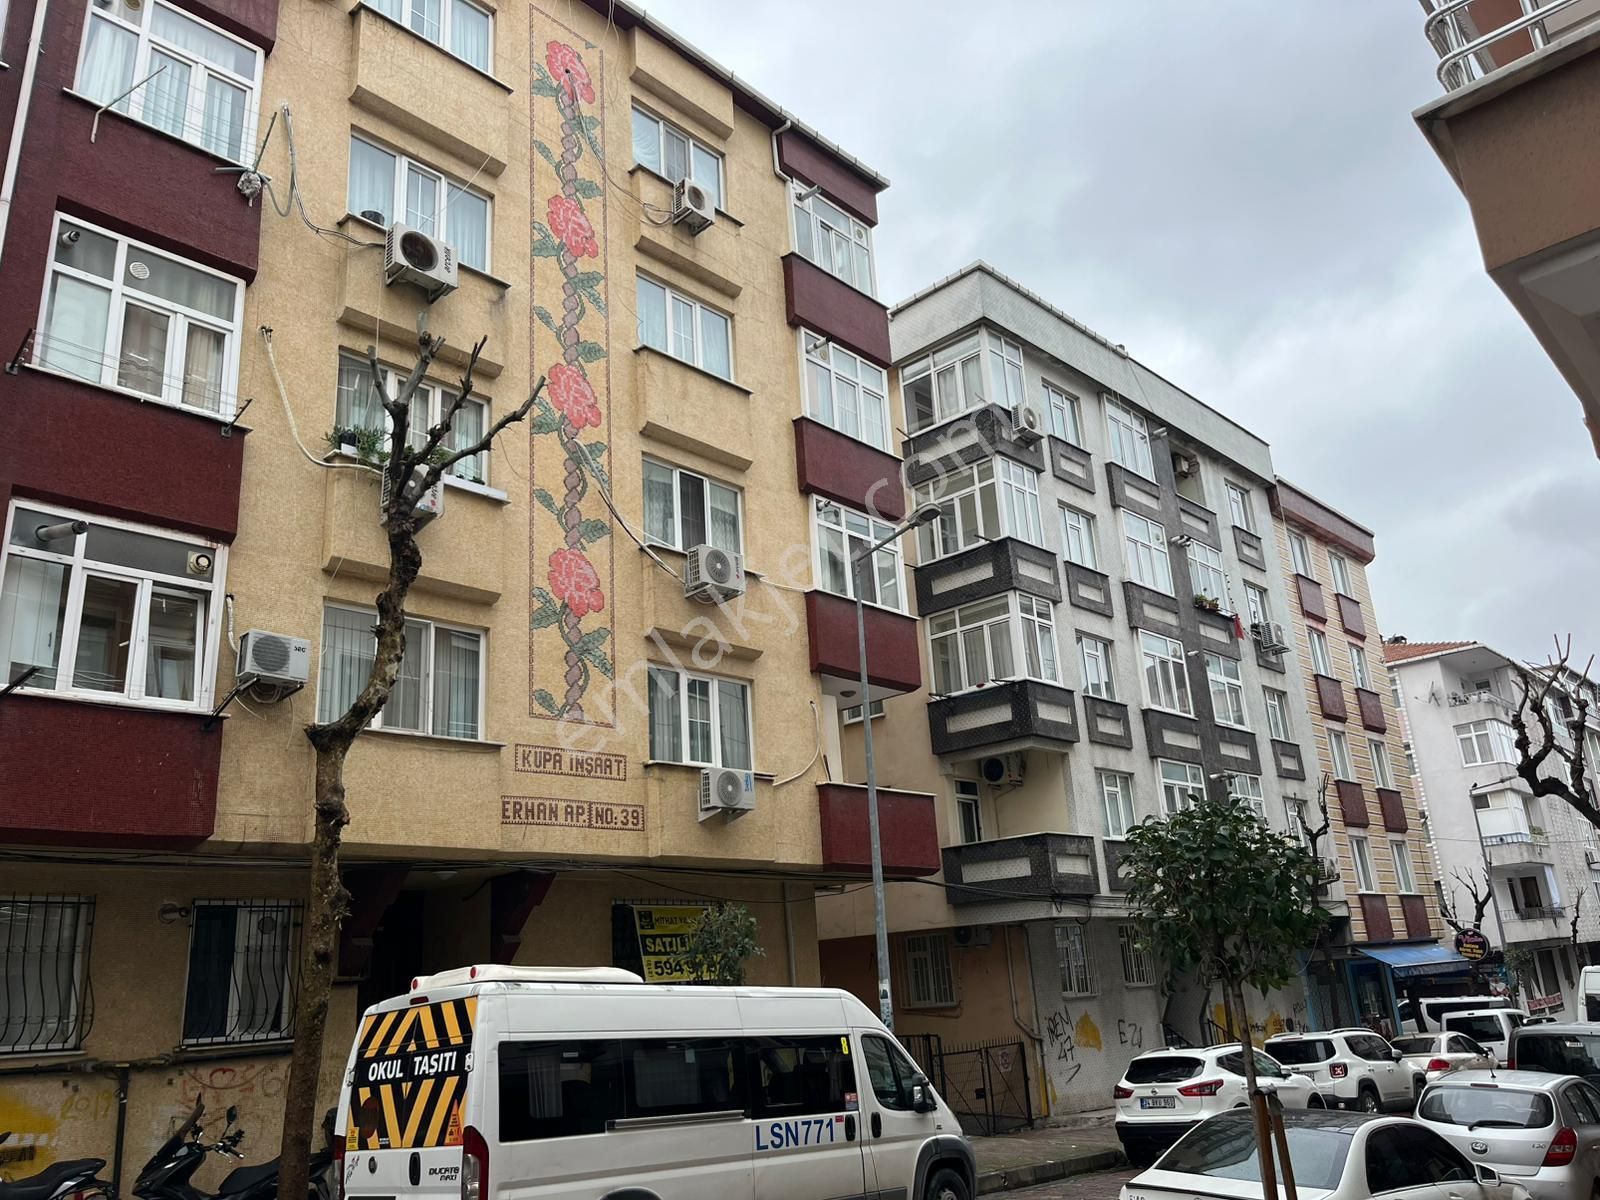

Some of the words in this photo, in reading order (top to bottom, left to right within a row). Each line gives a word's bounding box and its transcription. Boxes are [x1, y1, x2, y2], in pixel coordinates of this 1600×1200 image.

[522, 749, 562, 771] KUPA
[501, 800, 559, 822] ERHAN
[564, 804, 587, 824] AP.
[646, 935, 698, 953] SATILI
[840, 1036, 849, 1055] 8
[368, 1059, 404, 1082] OKUL
[414, 1051, 457, 1076] TAŞITI
[755, 1117, 835, 1151] LSN771
